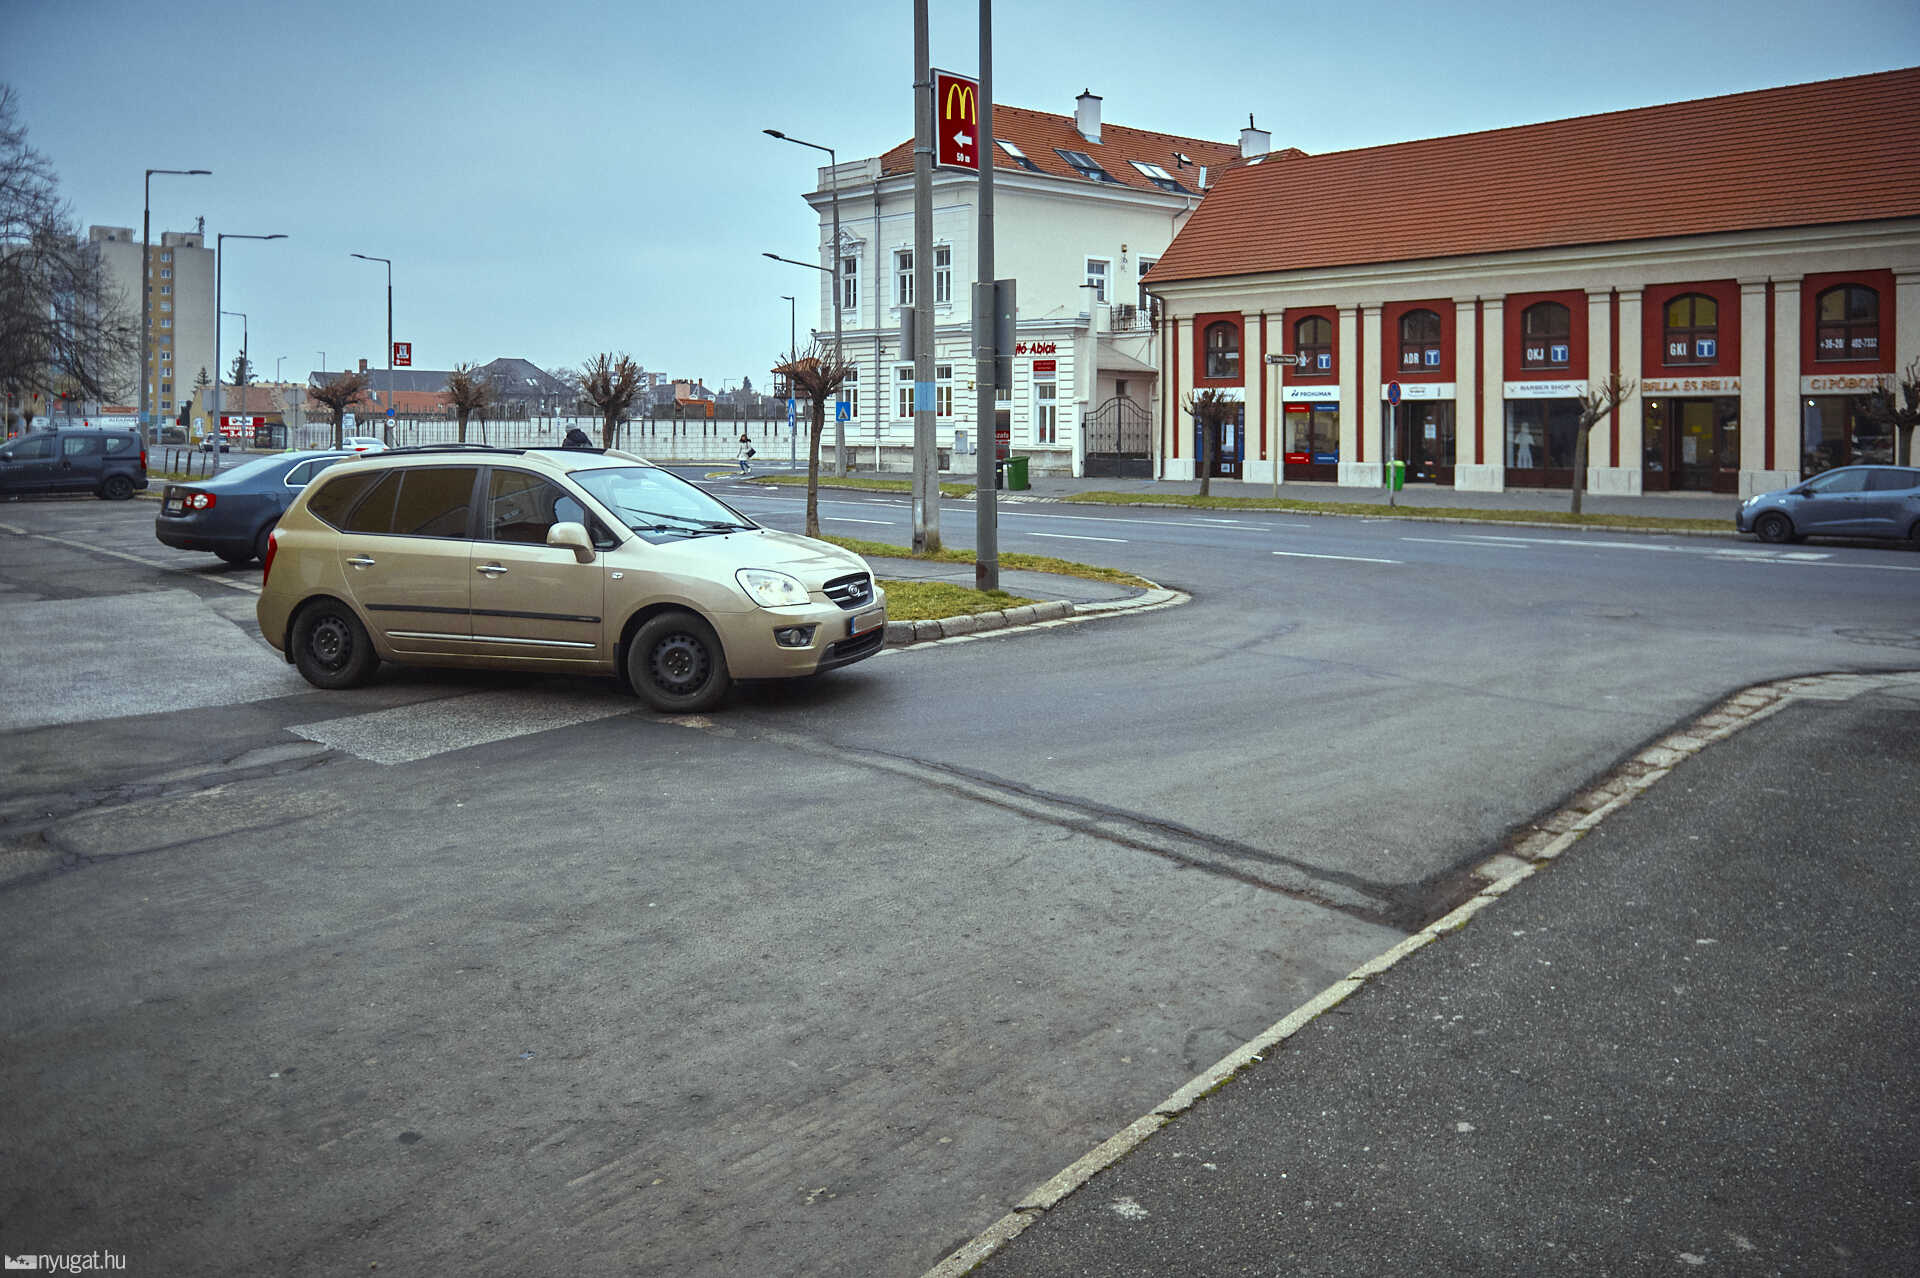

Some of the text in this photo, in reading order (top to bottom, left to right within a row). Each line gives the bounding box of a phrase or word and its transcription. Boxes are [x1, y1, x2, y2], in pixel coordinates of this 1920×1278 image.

[956, 152, 964, 162] 50
[1029, 341, 1057, 355] Ablak
[1527, 347, 1545, 361] OKJ
[1670, 342, 1687, 356] GKI
[1403, 352, 1420, 364] ADR
